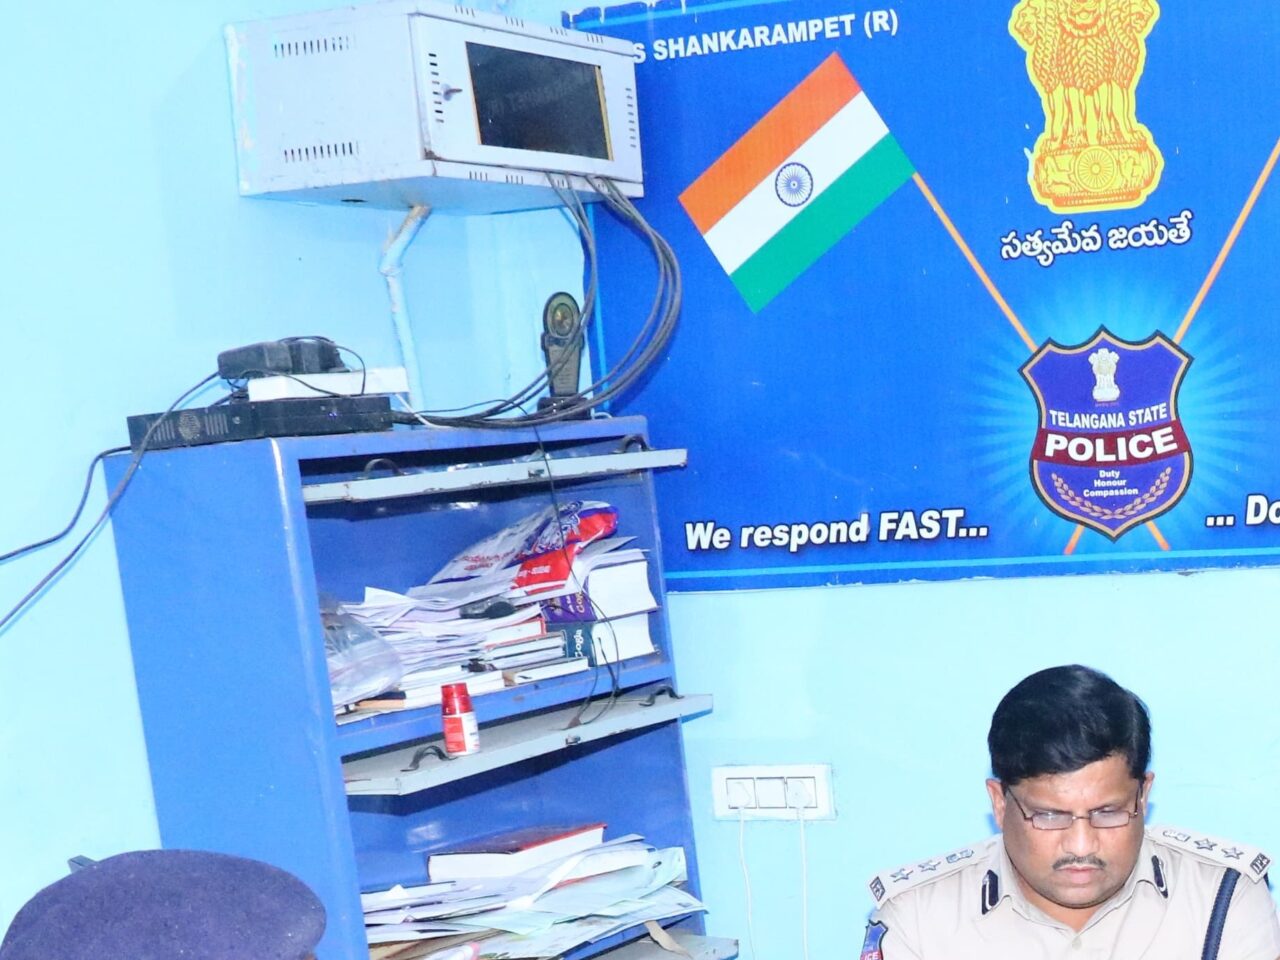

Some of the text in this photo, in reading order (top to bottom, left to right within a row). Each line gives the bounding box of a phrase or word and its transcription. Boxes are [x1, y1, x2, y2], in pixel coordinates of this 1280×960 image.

[653, 14, 856, 61] SHANKARAMPET
[864, 9, 898, 39] (R)
[1000, 209, 1194, 267] సత్యమేవ జయతే
[1049, 403, 1168, 429] TELANGANA STATE
[1045, 427, 1178, 462] POLICE
[1093, 478, 1127, 487] Honour
[1098, 469, 1120, 479] Duty
[1083, 488, 1139, 498] Compassion
[685, 509, 989, 553] We respond FAST...
